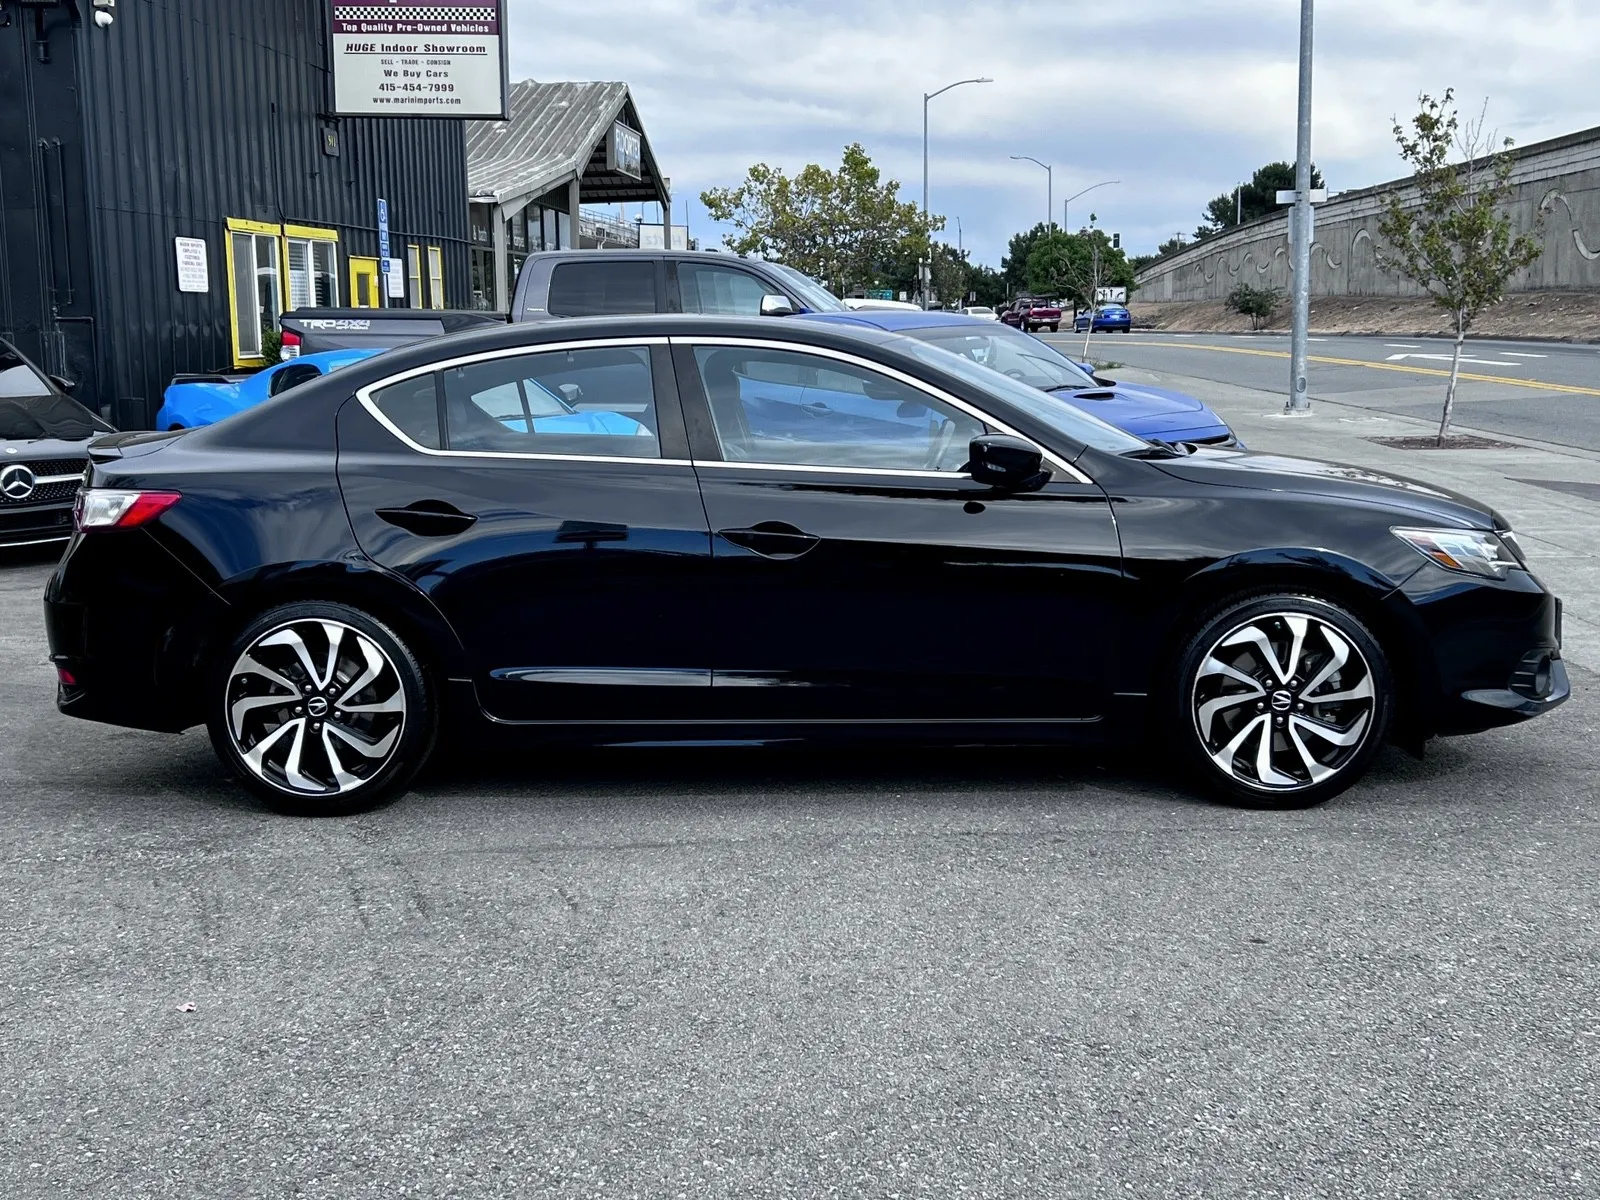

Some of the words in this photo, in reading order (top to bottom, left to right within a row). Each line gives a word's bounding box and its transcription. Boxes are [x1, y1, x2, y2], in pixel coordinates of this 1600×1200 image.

[341, 23, 358, 33] Top
[361, 23, 393, 33] Quality
[396, 23, 447, 32] Pre-Owned
[450, 23, 489, 33] Vehicles
[345, 43, 376, 52] HUGE
[381, 43, 418, 52] Indoor
[424, 43, 486, 53] Showroom
[383, 69, 399, 77] We
[403, 69, 421, 78] Buy
[426, 69, 449, 78] Cars
[379, 83, 454, 92] 415-454-7999
[372, 95, 461, 105] www.marinimports.com
